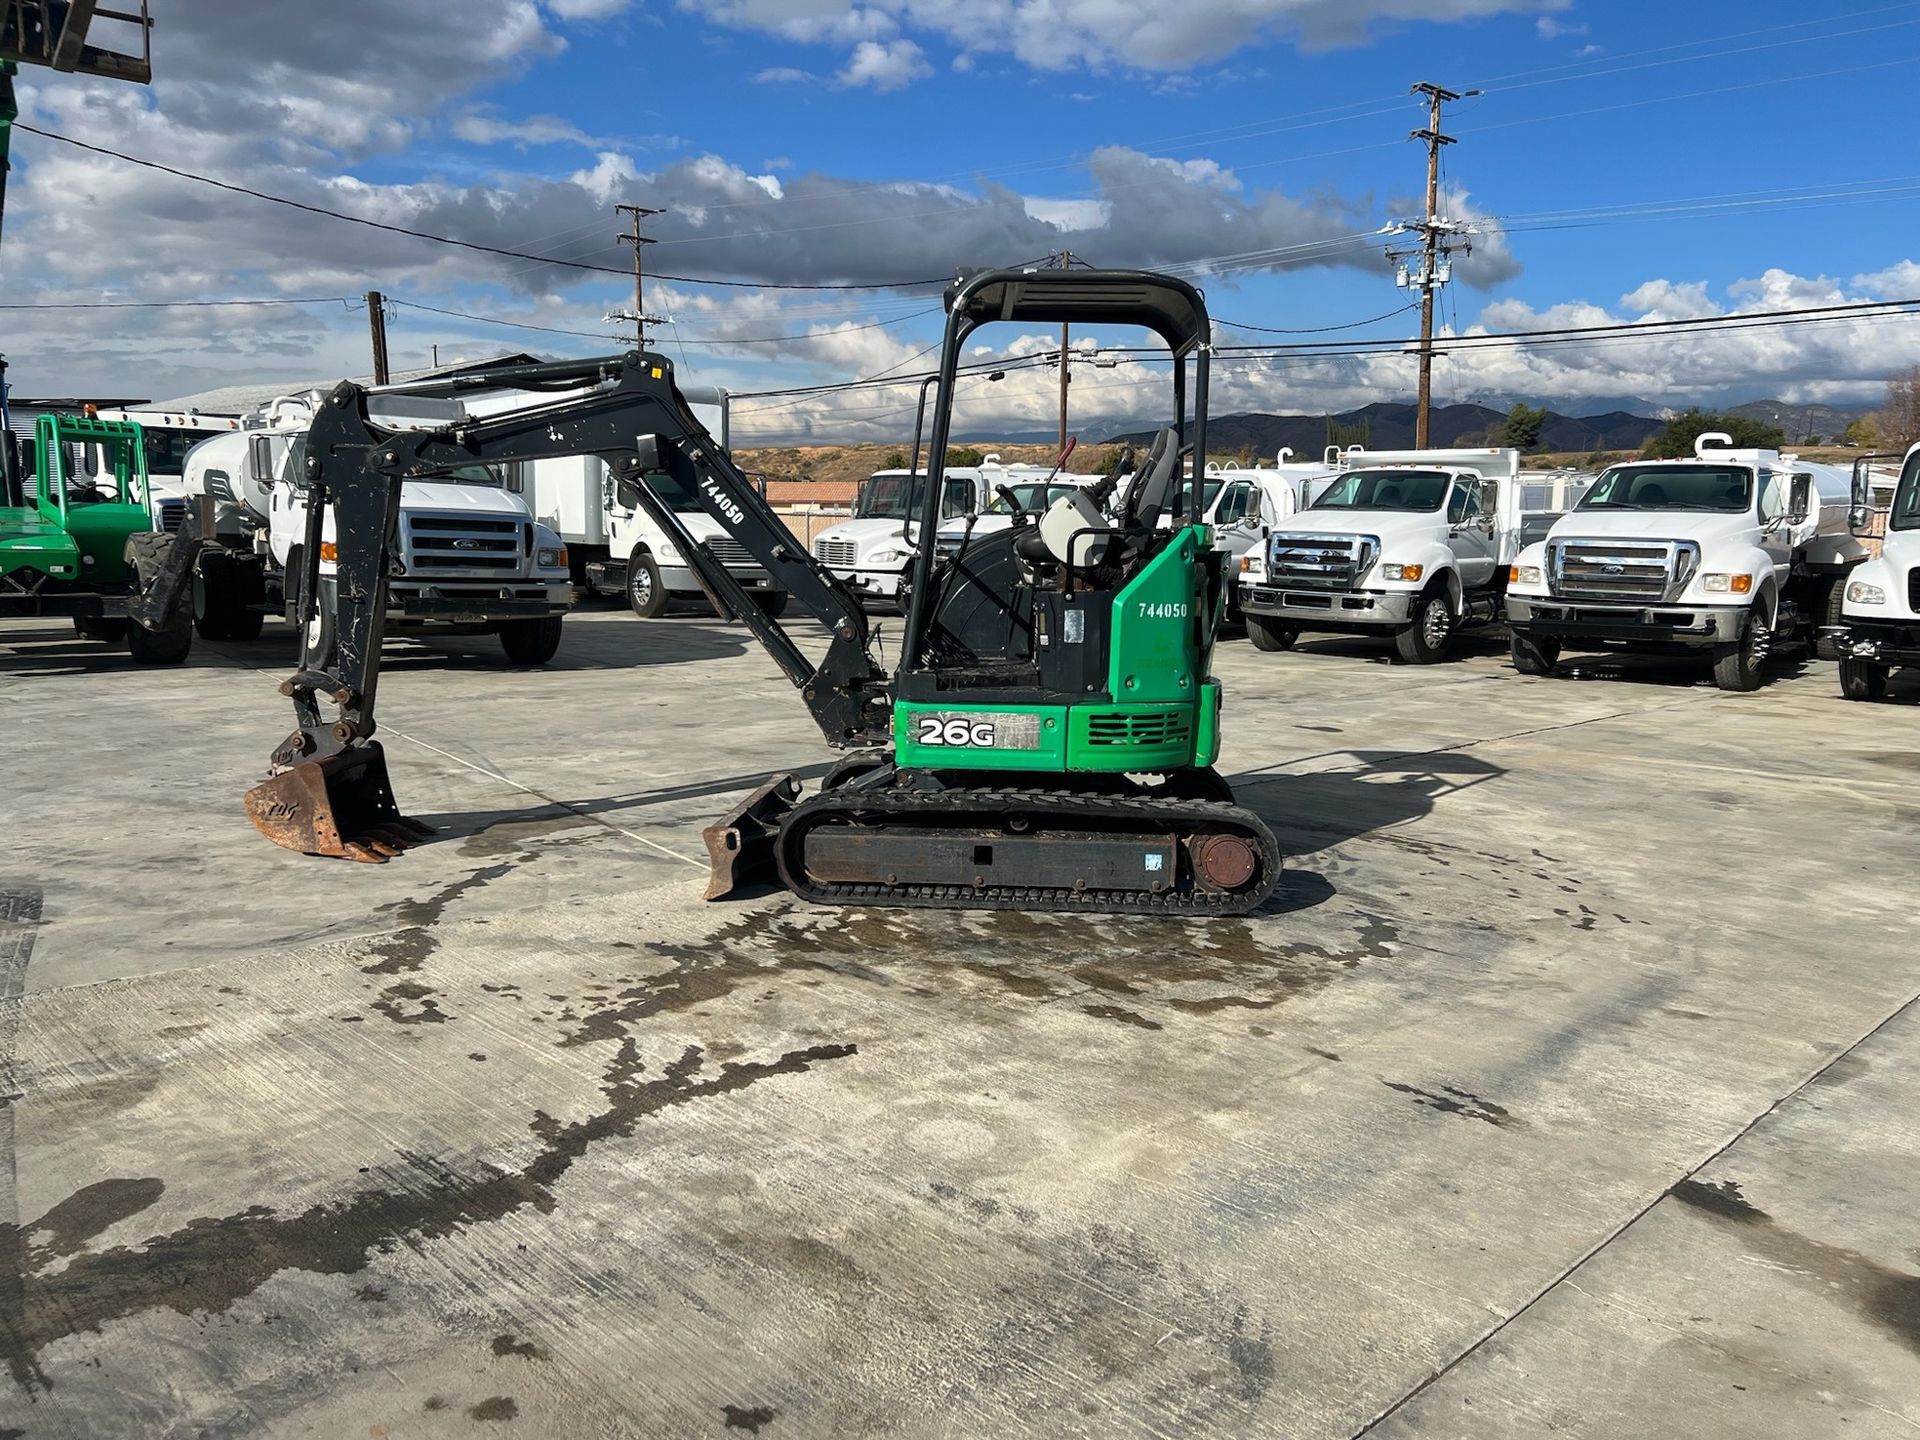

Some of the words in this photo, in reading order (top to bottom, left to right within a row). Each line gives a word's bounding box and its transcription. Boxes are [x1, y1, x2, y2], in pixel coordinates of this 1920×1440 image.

[701, 476, 744, 525] 744050
[1138, 602, 1187, 618] 744050
[919, 718, 994, 747] 26G
